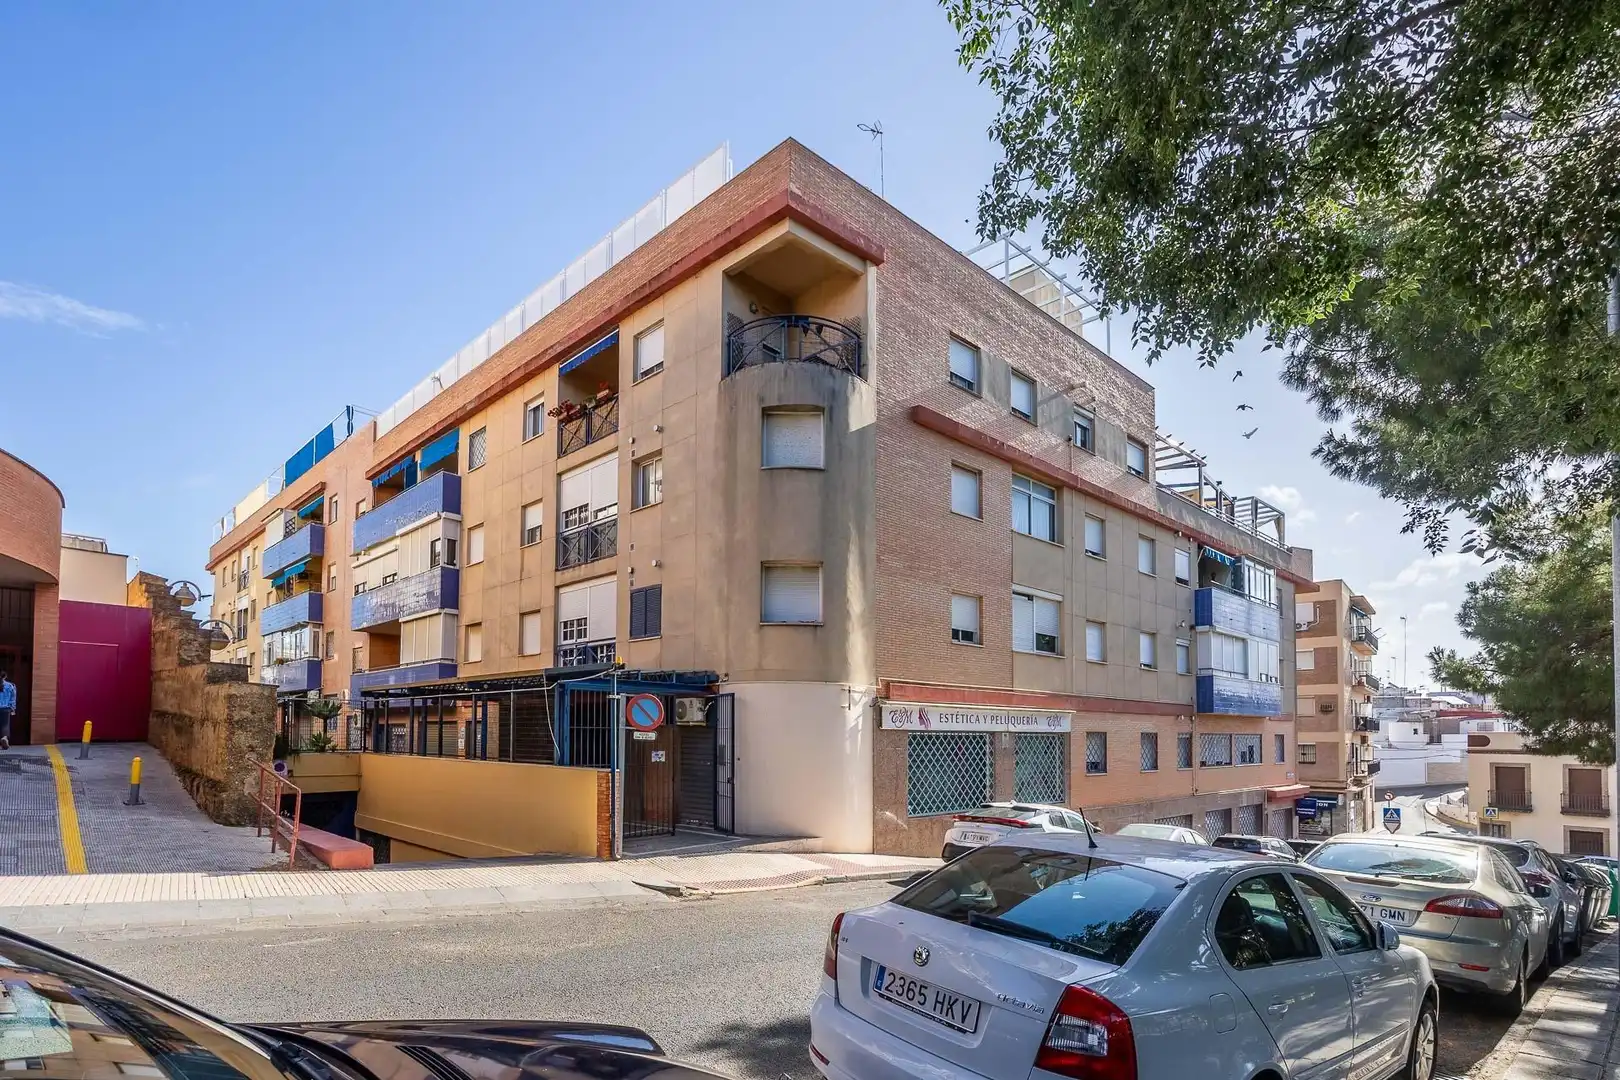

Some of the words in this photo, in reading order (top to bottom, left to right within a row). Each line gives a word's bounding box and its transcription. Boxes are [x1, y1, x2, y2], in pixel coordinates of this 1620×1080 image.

[939, 711, 981, 724] ESTÉTICA
[982, 715, 989, 724] Y
[990, 714, 1038, 728] PELUQUERÍA
[1380, 908, 1405, 922] GMN
[884, 972, 928, 1006] 2365
[933, 990, 972, 1024] HKV
